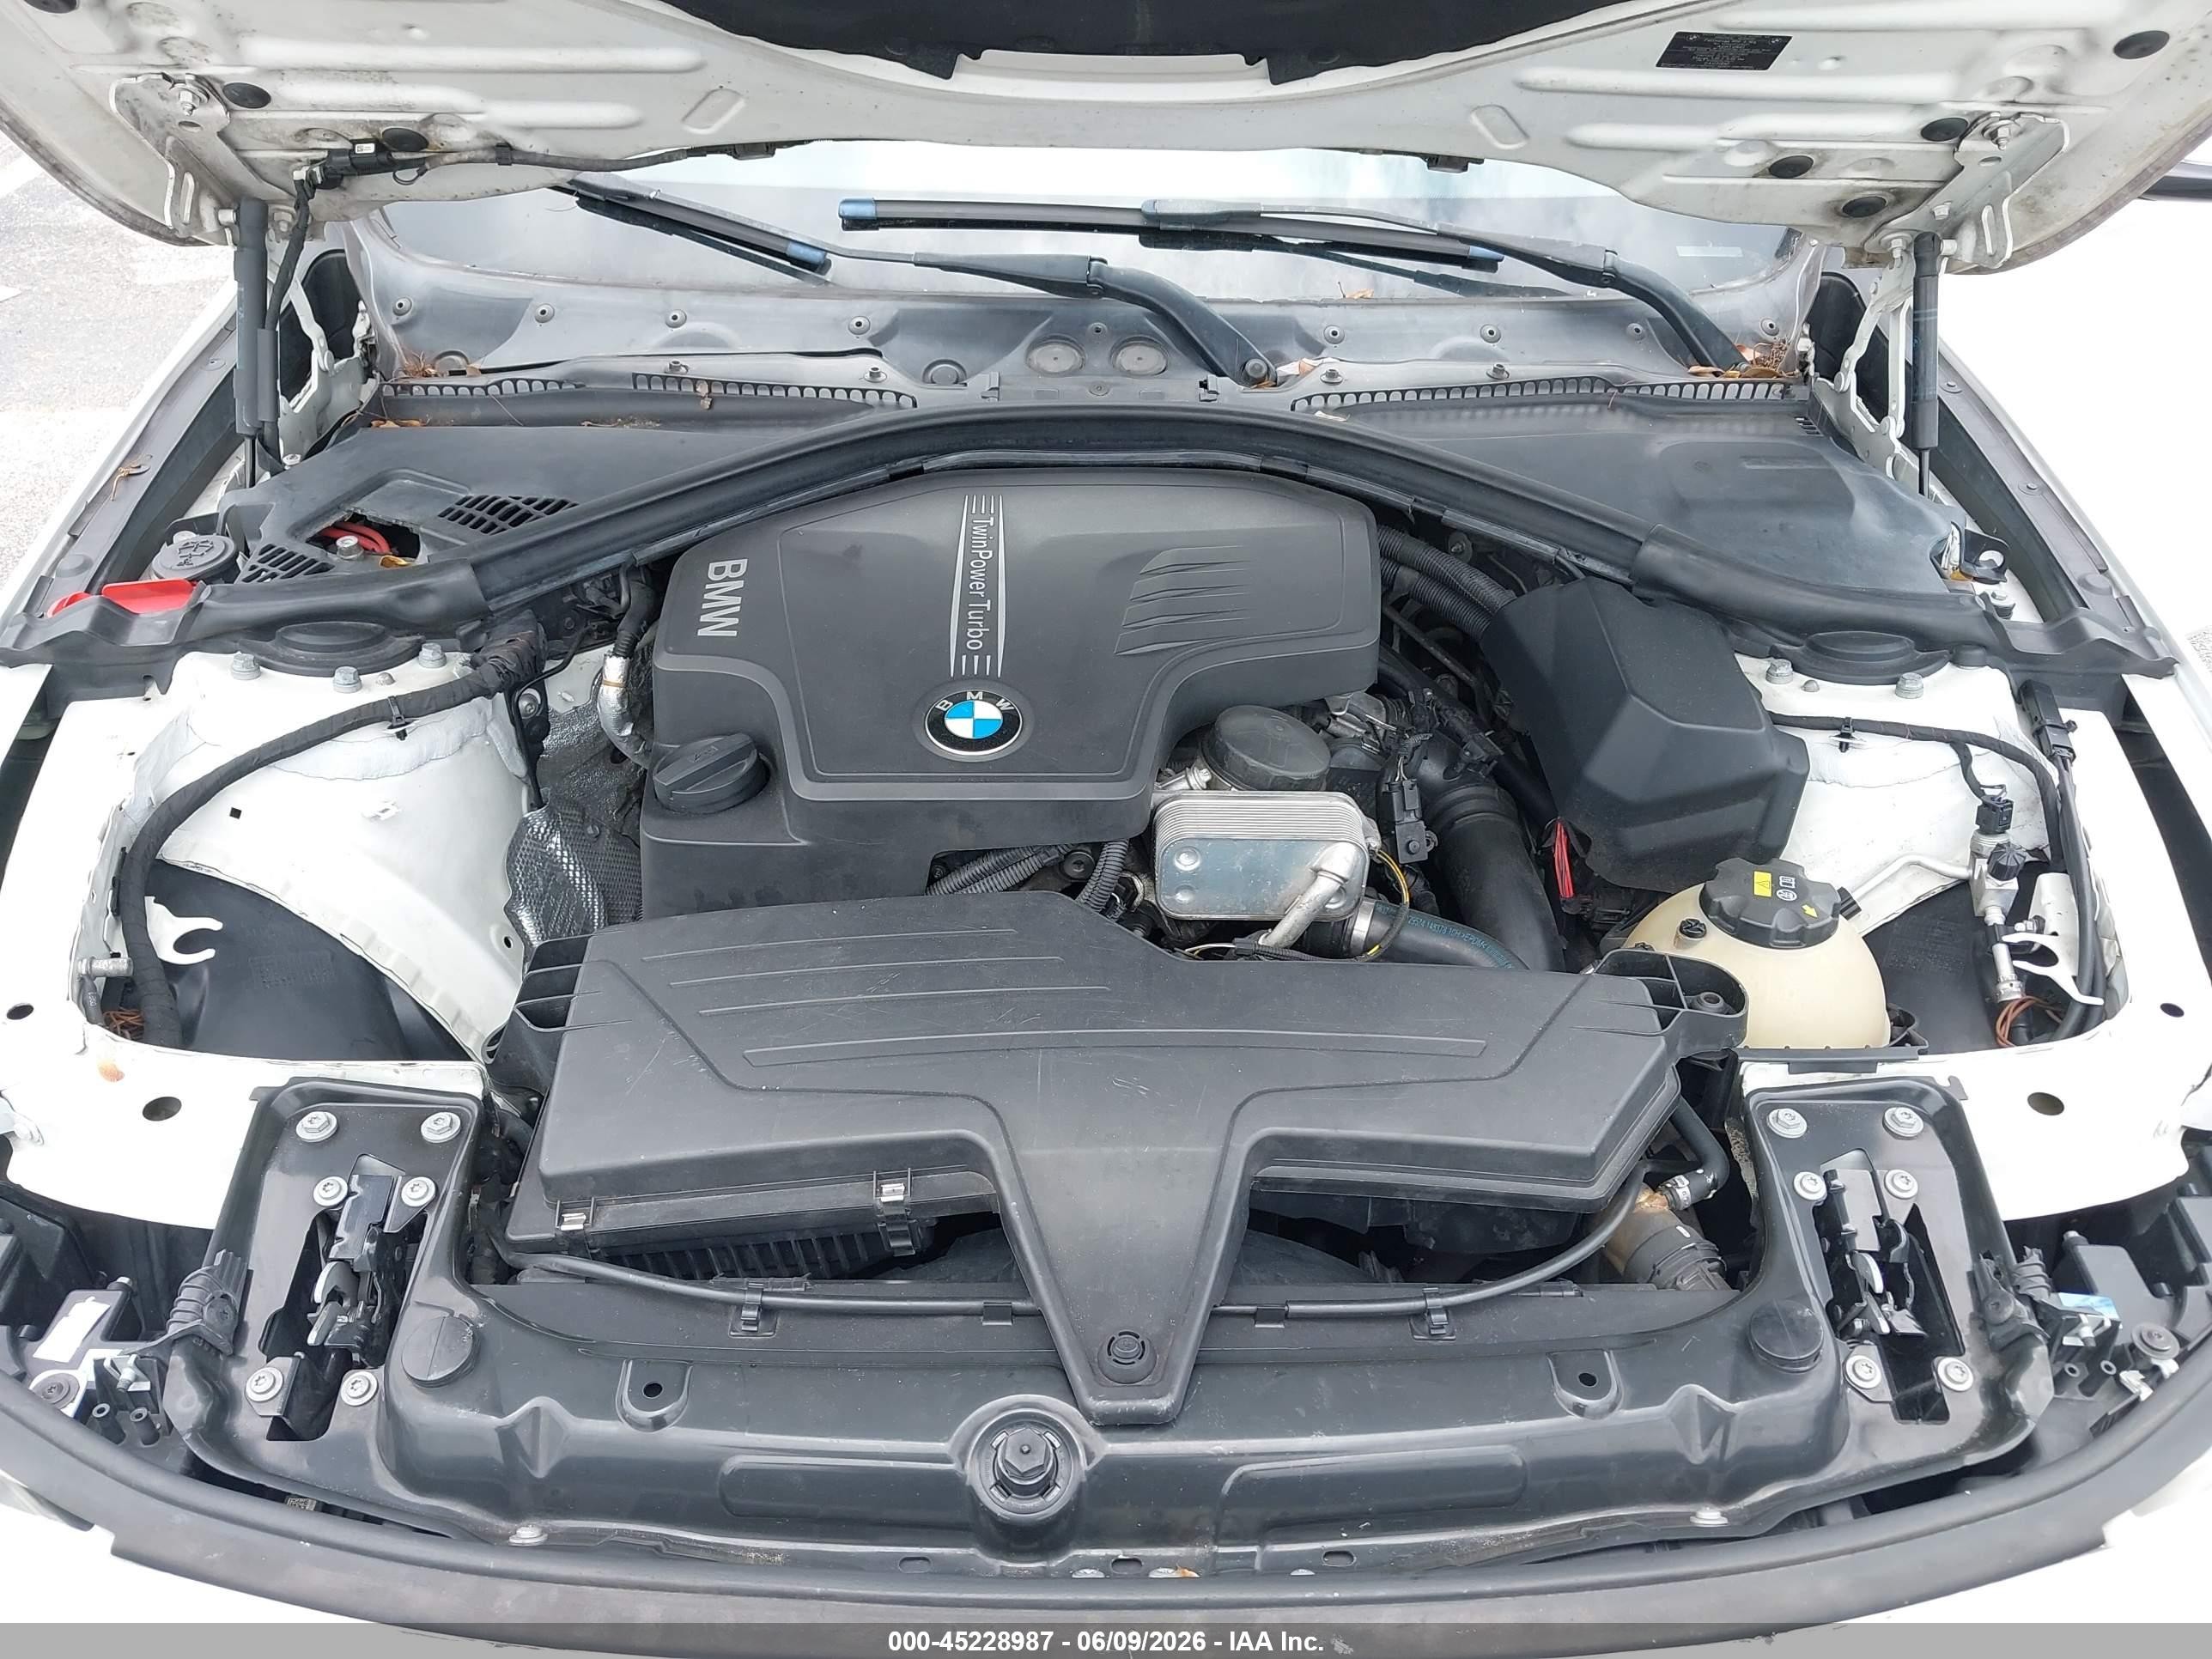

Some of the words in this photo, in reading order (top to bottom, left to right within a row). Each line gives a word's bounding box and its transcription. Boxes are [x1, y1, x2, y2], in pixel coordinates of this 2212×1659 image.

[969, 516, 994, 598] TwinPower
[697, 558, 748, 636] BMW
[966, 599, 991, 650] Turbo
[935, 691, 1014, 711] BMW
